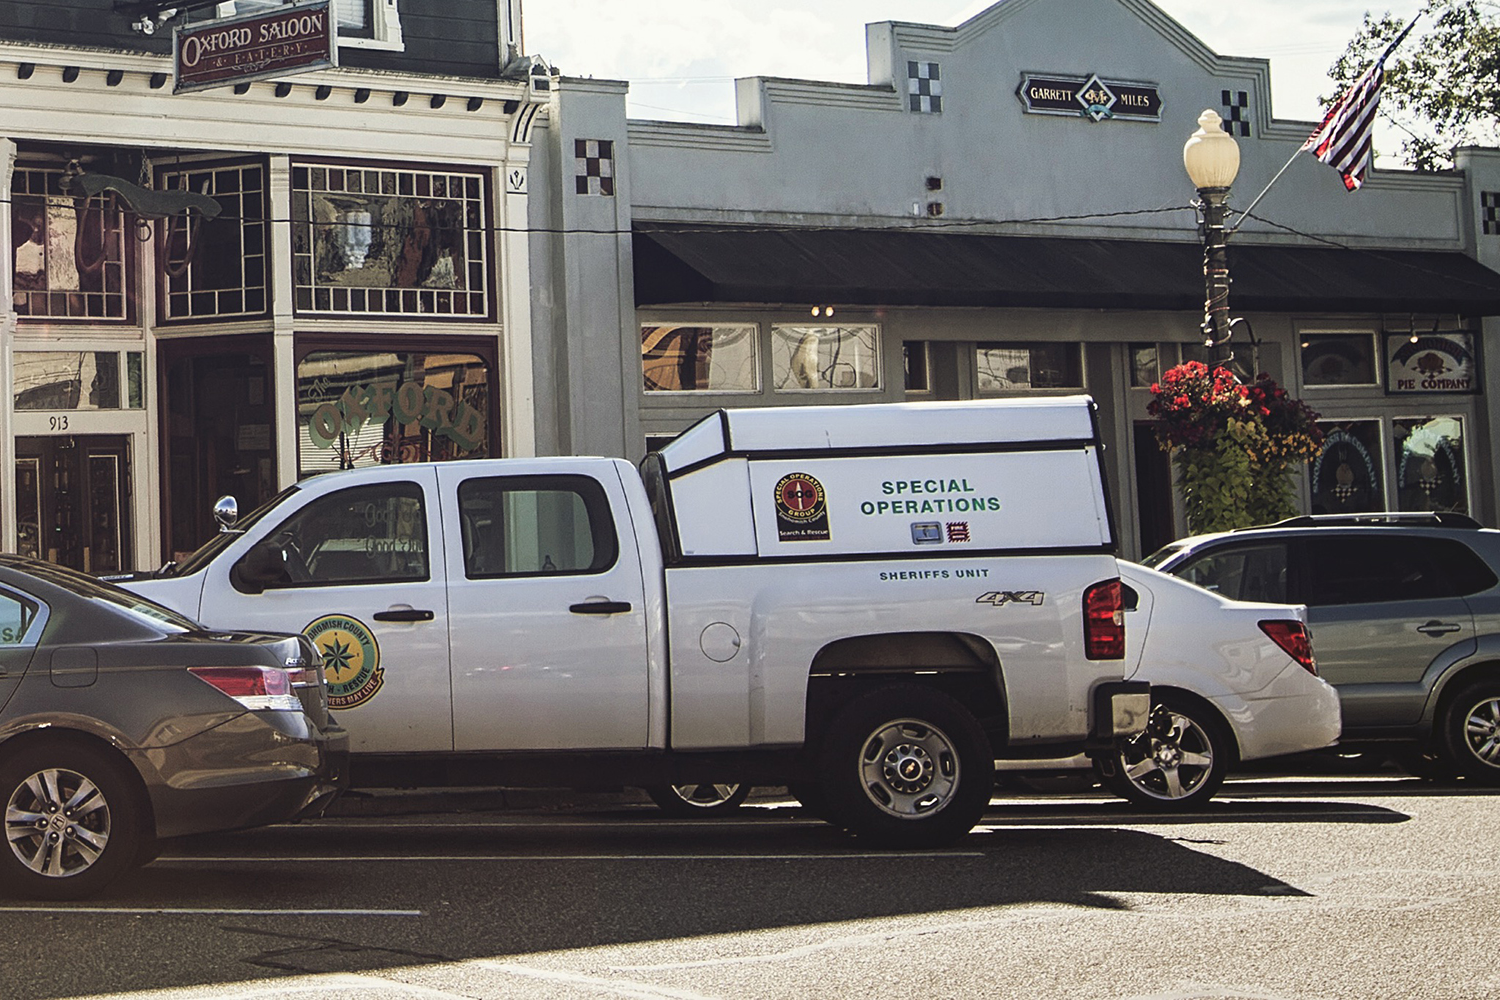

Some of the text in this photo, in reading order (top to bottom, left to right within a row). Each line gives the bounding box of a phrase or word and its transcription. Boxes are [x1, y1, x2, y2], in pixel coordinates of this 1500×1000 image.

[182, 14, 323, 67] OXFORD SALOON
[1030, 87, 1073, 101] GARRETT
[1120, 93, 1150, 107] MILES
[1398, 378, 1471, 390] PIE COMPANY
[49, 416, 69, 431] 913
[309, 381, 486, 448] OXFORD
[775, 473, 824, 504] SPECIAL OPERATIONS
[882, 479, 975, 495] SPECIAL
[788, 508, 815, 517] GROUP
[860, 497, 1001, 515] OPERATIONS
[880, 569, 989, 580] SHERIFFS UNIT
[308, 620, 370, 646] OHOMISH COUNTY
[343, 667, 370, 693] RESCUE
[347, 691, 363, 703] MAY
[362, 679, 377, 695] LIVE
